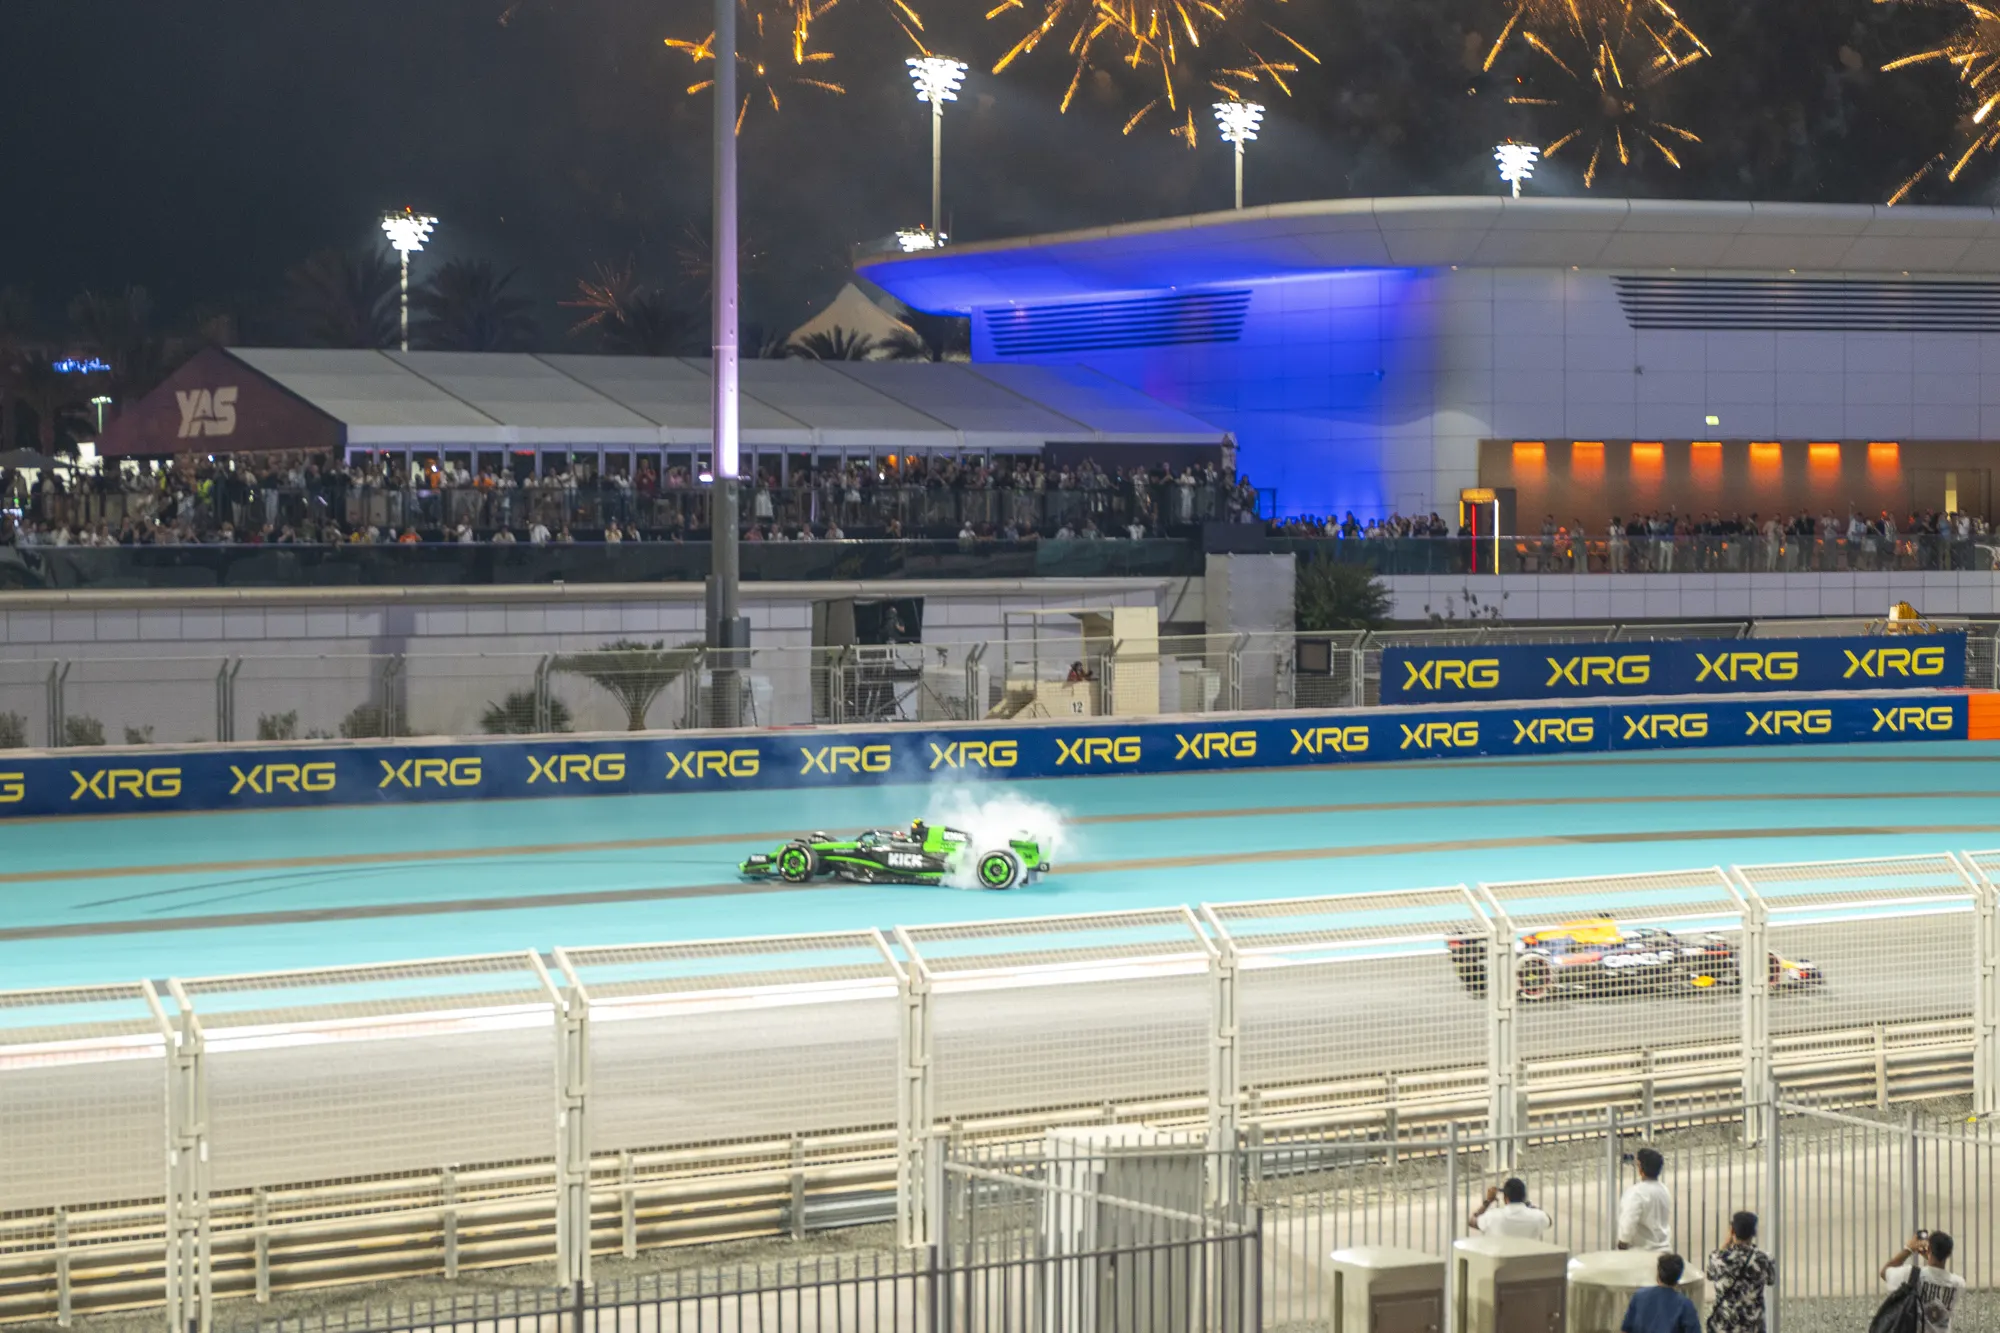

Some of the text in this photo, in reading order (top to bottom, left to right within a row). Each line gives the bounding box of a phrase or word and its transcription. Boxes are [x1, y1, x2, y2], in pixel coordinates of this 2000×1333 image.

[175, 386, 238, 438] YAS
[1403, 659, 1499, 690] XRG
[1547, 655, 1650, 686] XRG
[1696, 651, 1798, 682] XRG
[1844, 647, 1944, 678] XRG
[1072, 701, 1083, 713] 12
[1873, 707, 1952, 731] XRG
[1401, 722, 1478, 749] XRG
[1514, 718, 1593, 743] XRG
[1624, 713, 1707, 739] XRG
[1747, 710, 1831, 735] XRG
[1057, 736, 1140, 764] XRG
[1176, 731, 1256, 759] XRG
[1292, 726, 1368, 754] XRG
[528, 754, 624, 782] XRG
[667, 750, 759, 778] XRG
[802, 745, 890, 773] XRG
[931, 741, 1017, 768] XRG
[72, 768, 181, 799] XRG
[231, 763, 335, 793] XRG
[380, 758, 481, 787] XRG
[888, 852, 923, 868] KICK
